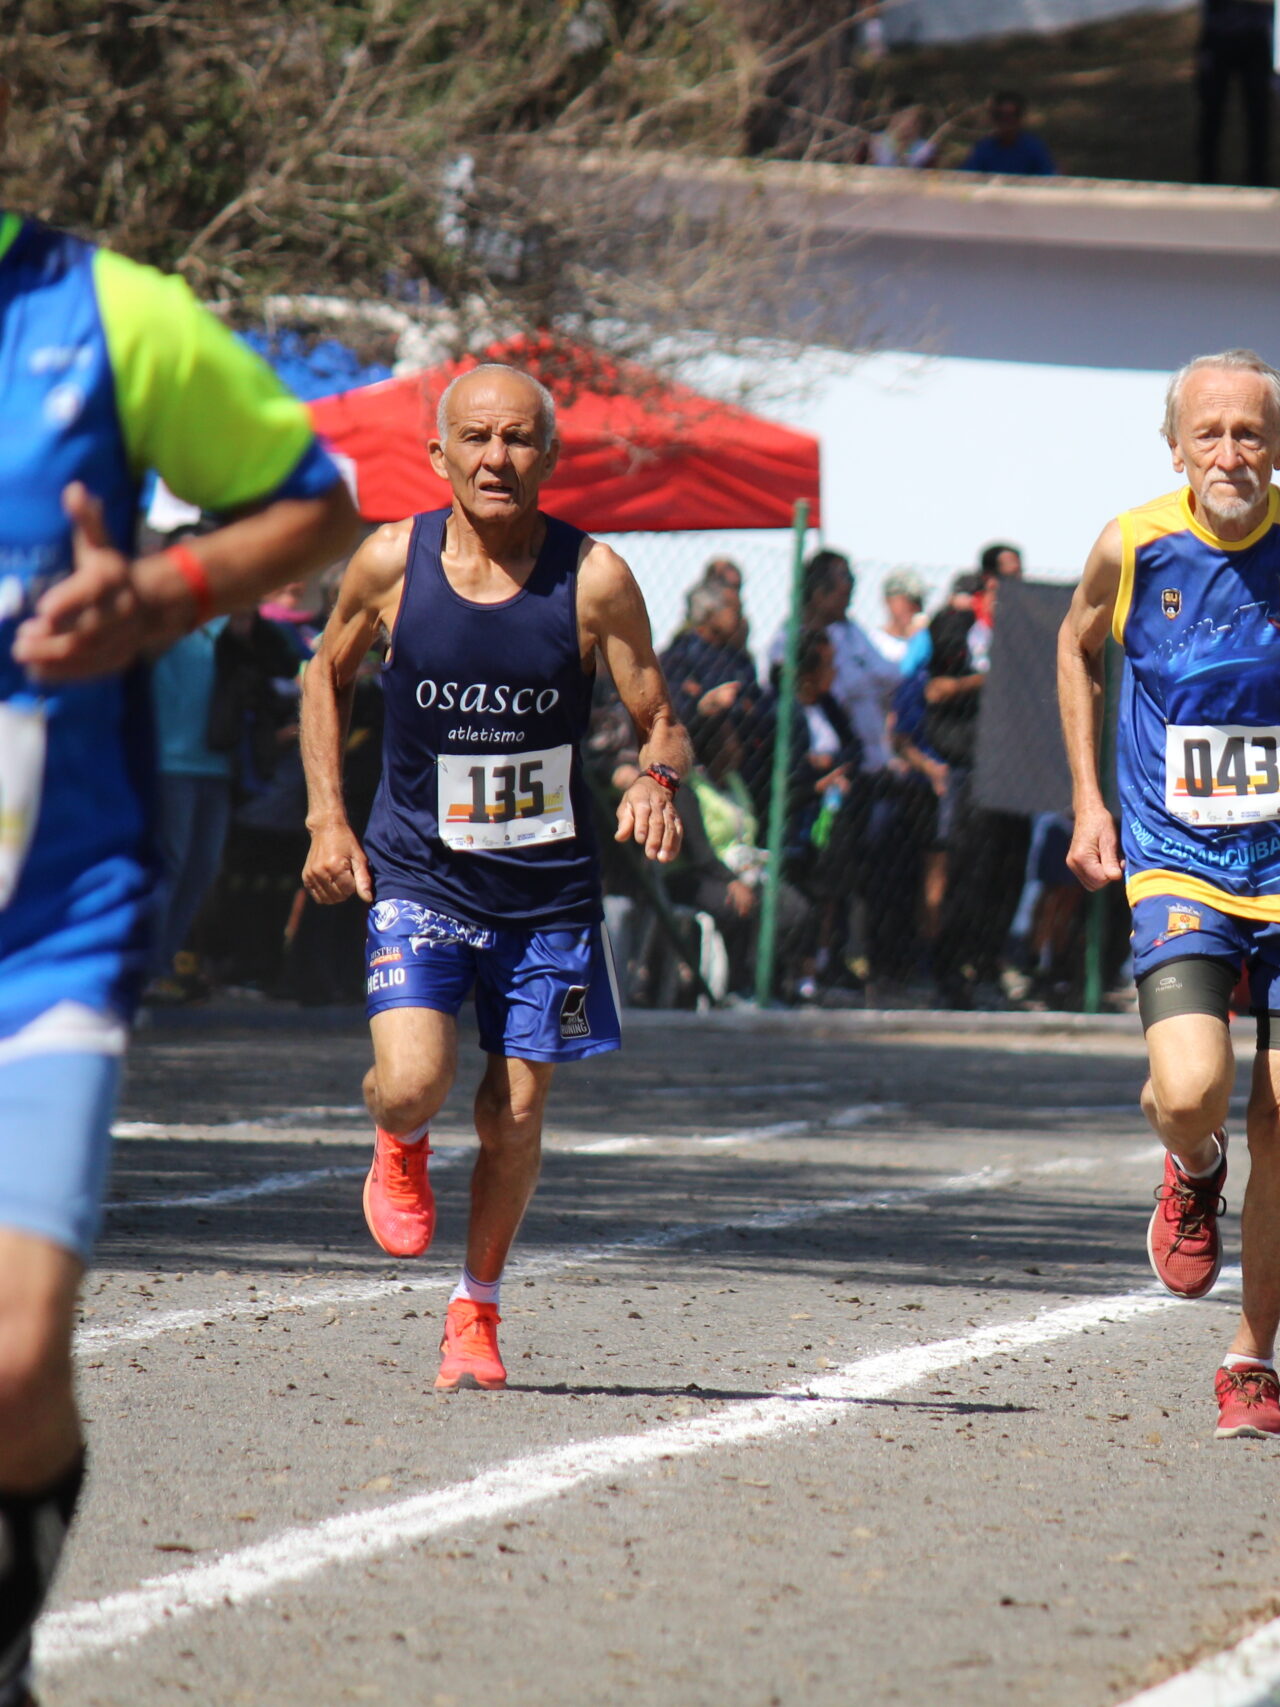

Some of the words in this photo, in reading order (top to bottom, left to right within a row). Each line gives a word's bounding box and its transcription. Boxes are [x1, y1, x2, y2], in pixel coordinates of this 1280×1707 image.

[448, 725, 525, 742] atletismo
[1184, 736, 1280, 797] 043
[468, 760, 545, 823] 135
[367, 967, 406, 995] HÉLIO
